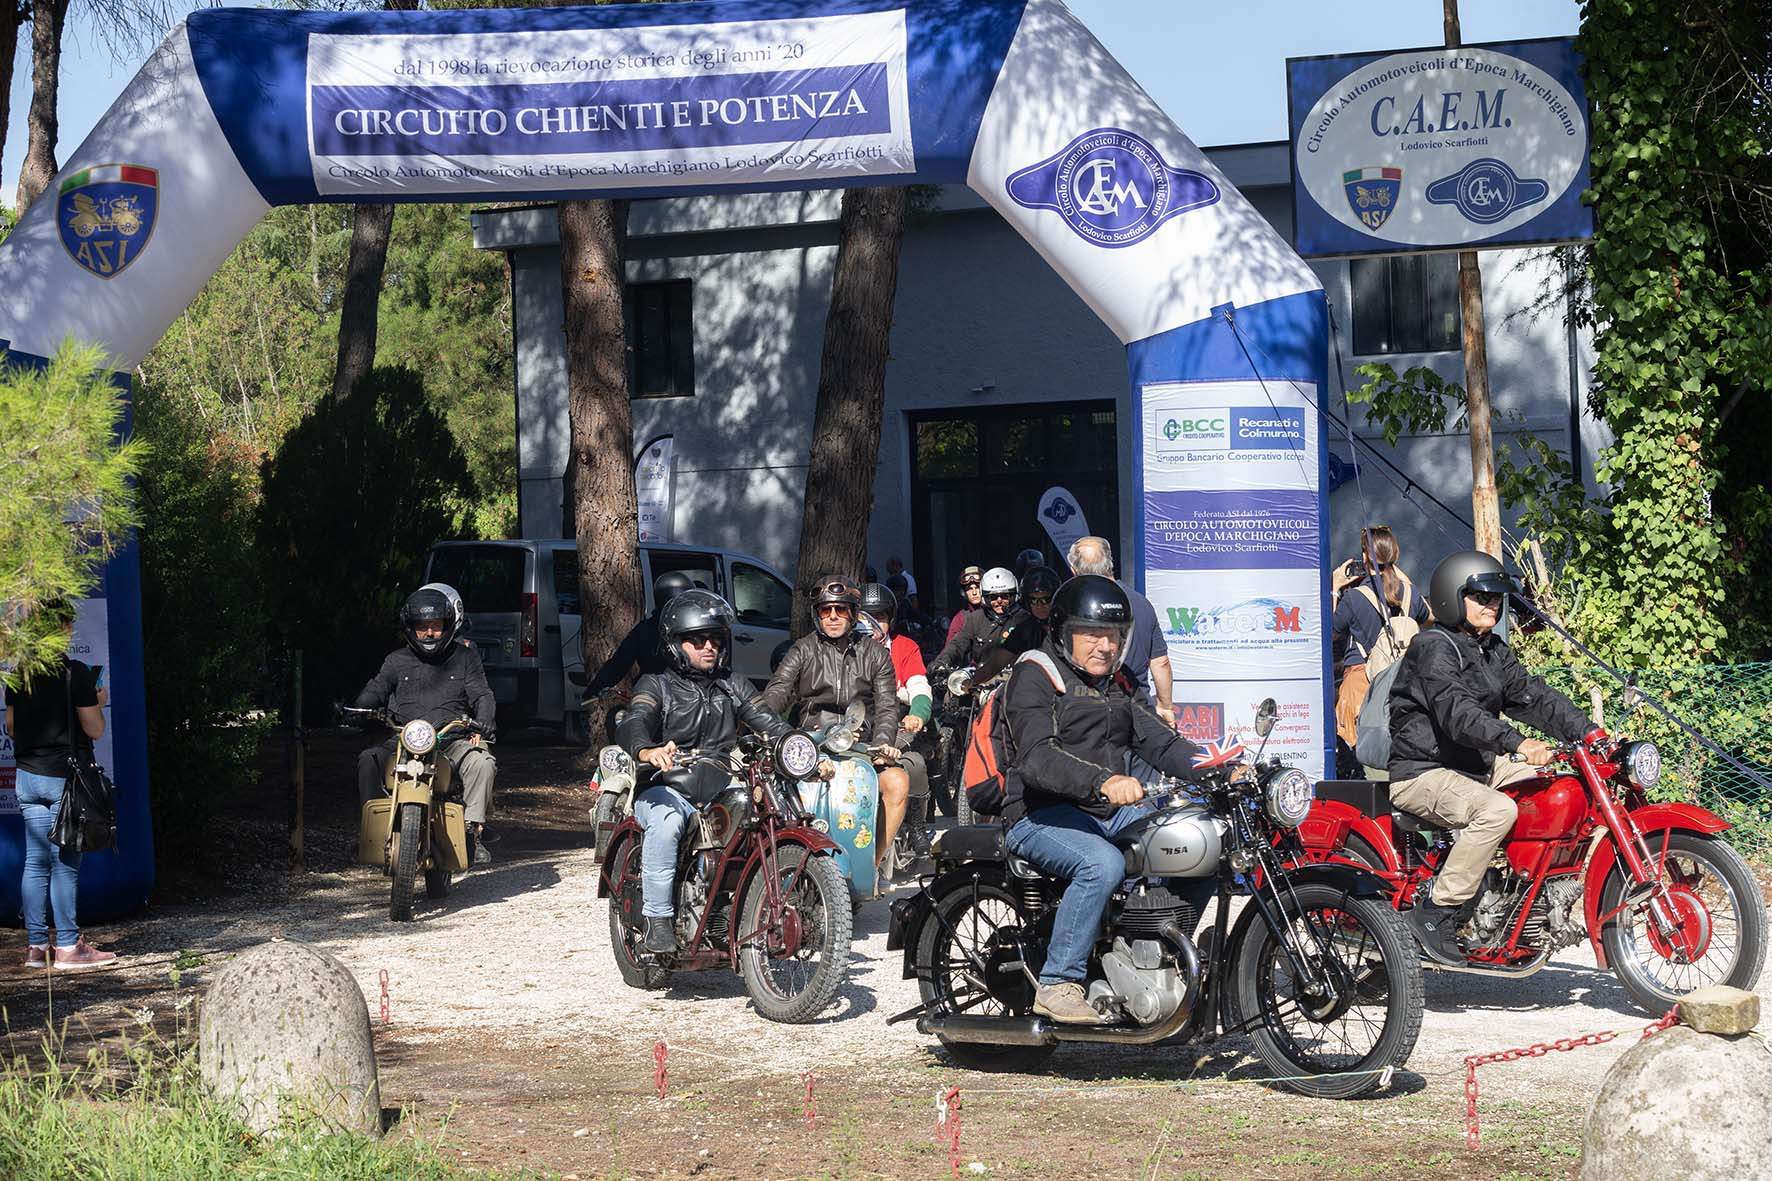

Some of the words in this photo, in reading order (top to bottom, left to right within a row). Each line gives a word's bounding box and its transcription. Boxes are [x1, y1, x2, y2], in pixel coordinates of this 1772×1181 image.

[394, 59, 423, 75] dal
[428, 59, 470, 75] 1998
[474, 59, 489, 74] la
[495, 55, 612, 74] rievocazione
[617, 51, 676, 69] storica
[681, 48, 726, 70] degli
[731, 46, 773, 63] anni
[335, 108, 507, 136] CIRCUITO
[515, 103, 666, 135] CHIENTI
[671, 101, 692, 128] E
[698, 88, 868, 127] POTENZA
[1307, 107, 1340, 154] Circolo
[1338, 57, 1445, 109] Automotoveicoli
[1449, 57, 1507, 78] d'Epoca
[1510, 69, 1576, 137] Marchigiano
[1370, 88, 1512, 137] C.A.E.M.
[1400, 139, 1443, 151] Lodovico
[1445, 136, 1489, 149] Scarfiotti
[328, 165, 389, 178] Circolo
[394, 164, 535, 179] Automotoveicoli
[539, 163, 607, 180] d'Epoca
[613, 160, 720, 176] Marchigiano
[725, 153, 805, 170] Lodovico
[808, 145, 883, 163] Scarfiotti
[1058, 135, 1120, 182] Automotoveicoli
[1150, 161, 1168, 217] Marchigiano
[1058, 183, 1075, 217] Circolo
[1361, 210, 1387, 227] ASI
[1078, 221, 1113, 242] Lodovico
[1114, 223, 1149, 242] Scarfiotti
[1182, 419, 1225, 432] BCC
[1239, 418, 1291, 428] Recanati
[1292, 419, 1300, 428] e
[1239, 428, 1300, 438] Colmurano
[1156, 453, 1185, 464] Gruppo
[1187, 452, 1225, 462] Bancario
[1228, 451, 1282, 463] Cooperativo
[1193, 510, 1224, 518] Federato
[1154, 520, 1198, 530] CIRCOLO
[1201, 519, 1310, 530] AUTOMOTOVEICOLI
[1165, 531, 1211, 541] D'EPOCA
[1214, 530, 1300, 541] MARCHIGIANO
[1187, 543, 1232, 553] Lodovico
[1235, 542, 1278, 552] Scarfiotti
